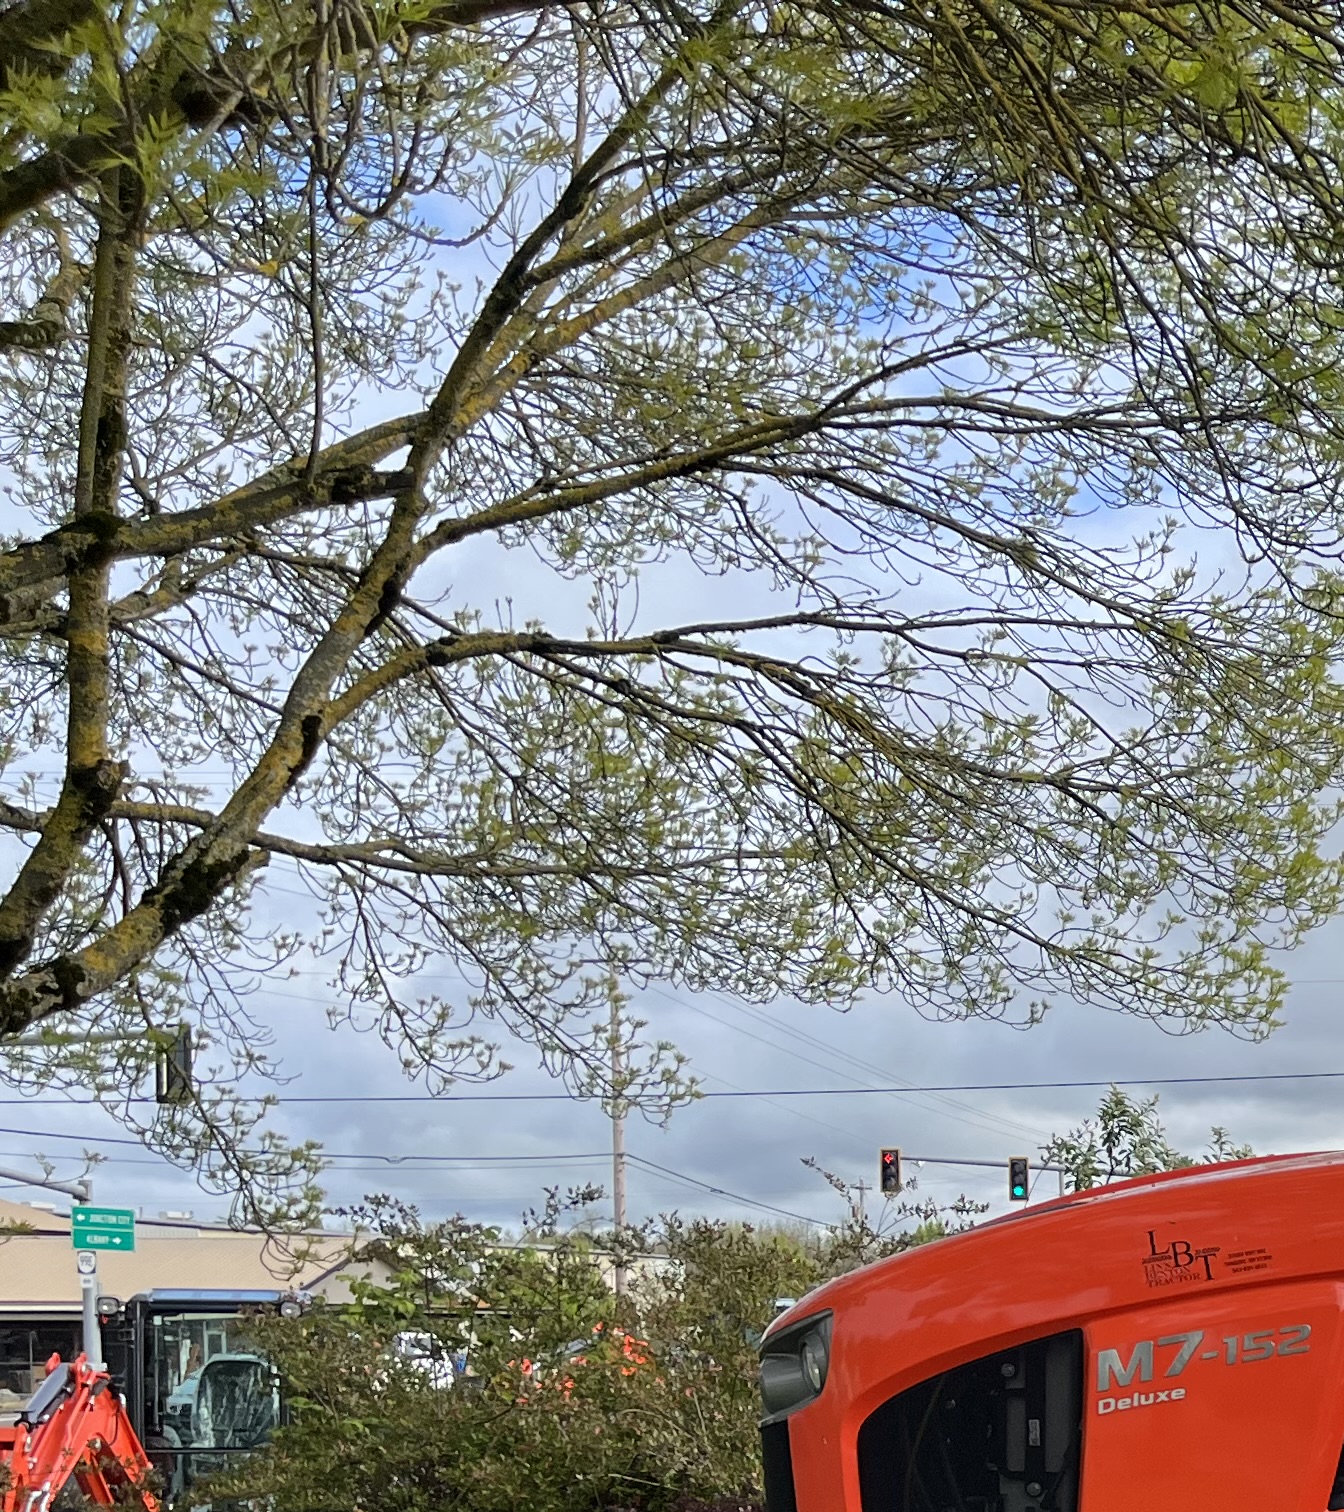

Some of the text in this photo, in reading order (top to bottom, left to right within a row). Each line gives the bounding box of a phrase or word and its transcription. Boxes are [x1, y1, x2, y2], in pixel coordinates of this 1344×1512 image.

[1147, 1272, 1201, 1288] TRACTOR
[1096, 1324, 1312, 1392] M7-152
[1097, 1386, 1187, 1416] Deluxe
